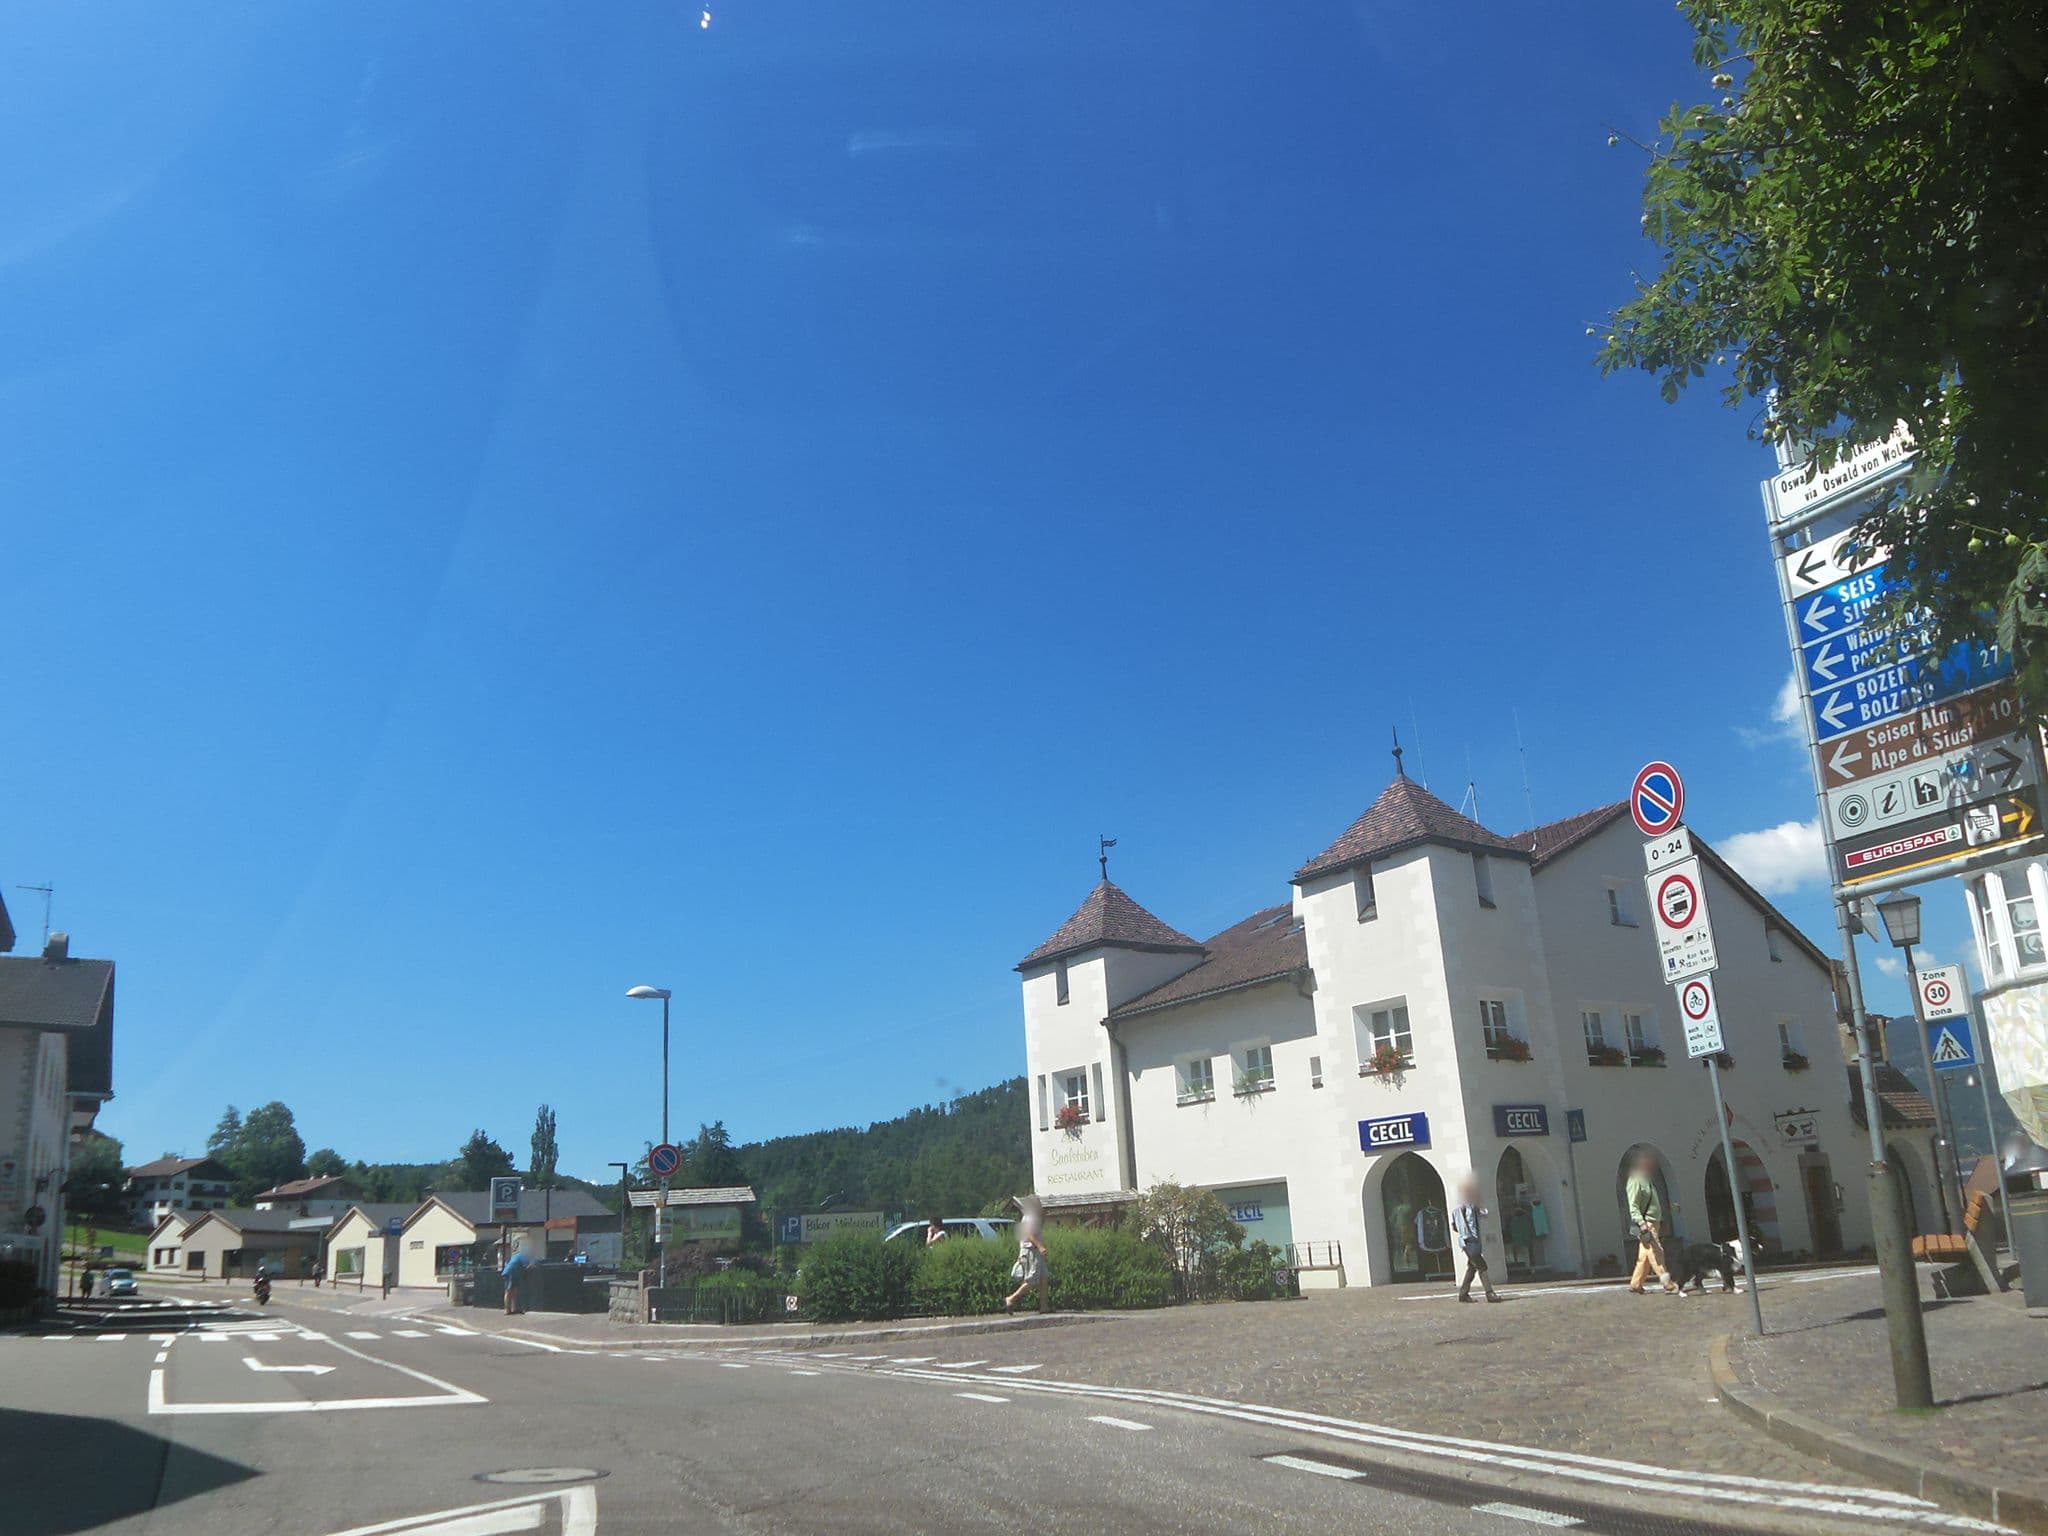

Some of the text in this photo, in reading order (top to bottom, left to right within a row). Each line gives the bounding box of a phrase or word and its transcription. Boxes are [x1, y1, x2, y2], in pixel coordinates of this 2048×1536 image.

[1804, 488, 1818, 501] via
[1823, 466, 1858, 491] Oswald
[1860, 461, 1880, 474] von
[1838, 574, 1876, 602] SEIS
[1980, 645, 1999, 668] 27
[1860, 681, 1934, 721] BOLZANO
[1990, 699, 2012, 721] 10
[1866, 701, 1953, 748] Seiser Alm
[1871, 722, 1974, 771] Alpe di Siusi
[1667, 839, 1682, 854] 24
[1863, 832, 1945, 860] EUROSPAR
[1922, 971, 1946, 981] Zone
[1930, 986, 1946, 999] 30
[1930, 1008, 1953, 1017] zona
[1507, 1112, 1541, 1128] CECIL
[1369, 1122, 1414, 1142] CECIL
[788, 1217, 799, 1232] P
